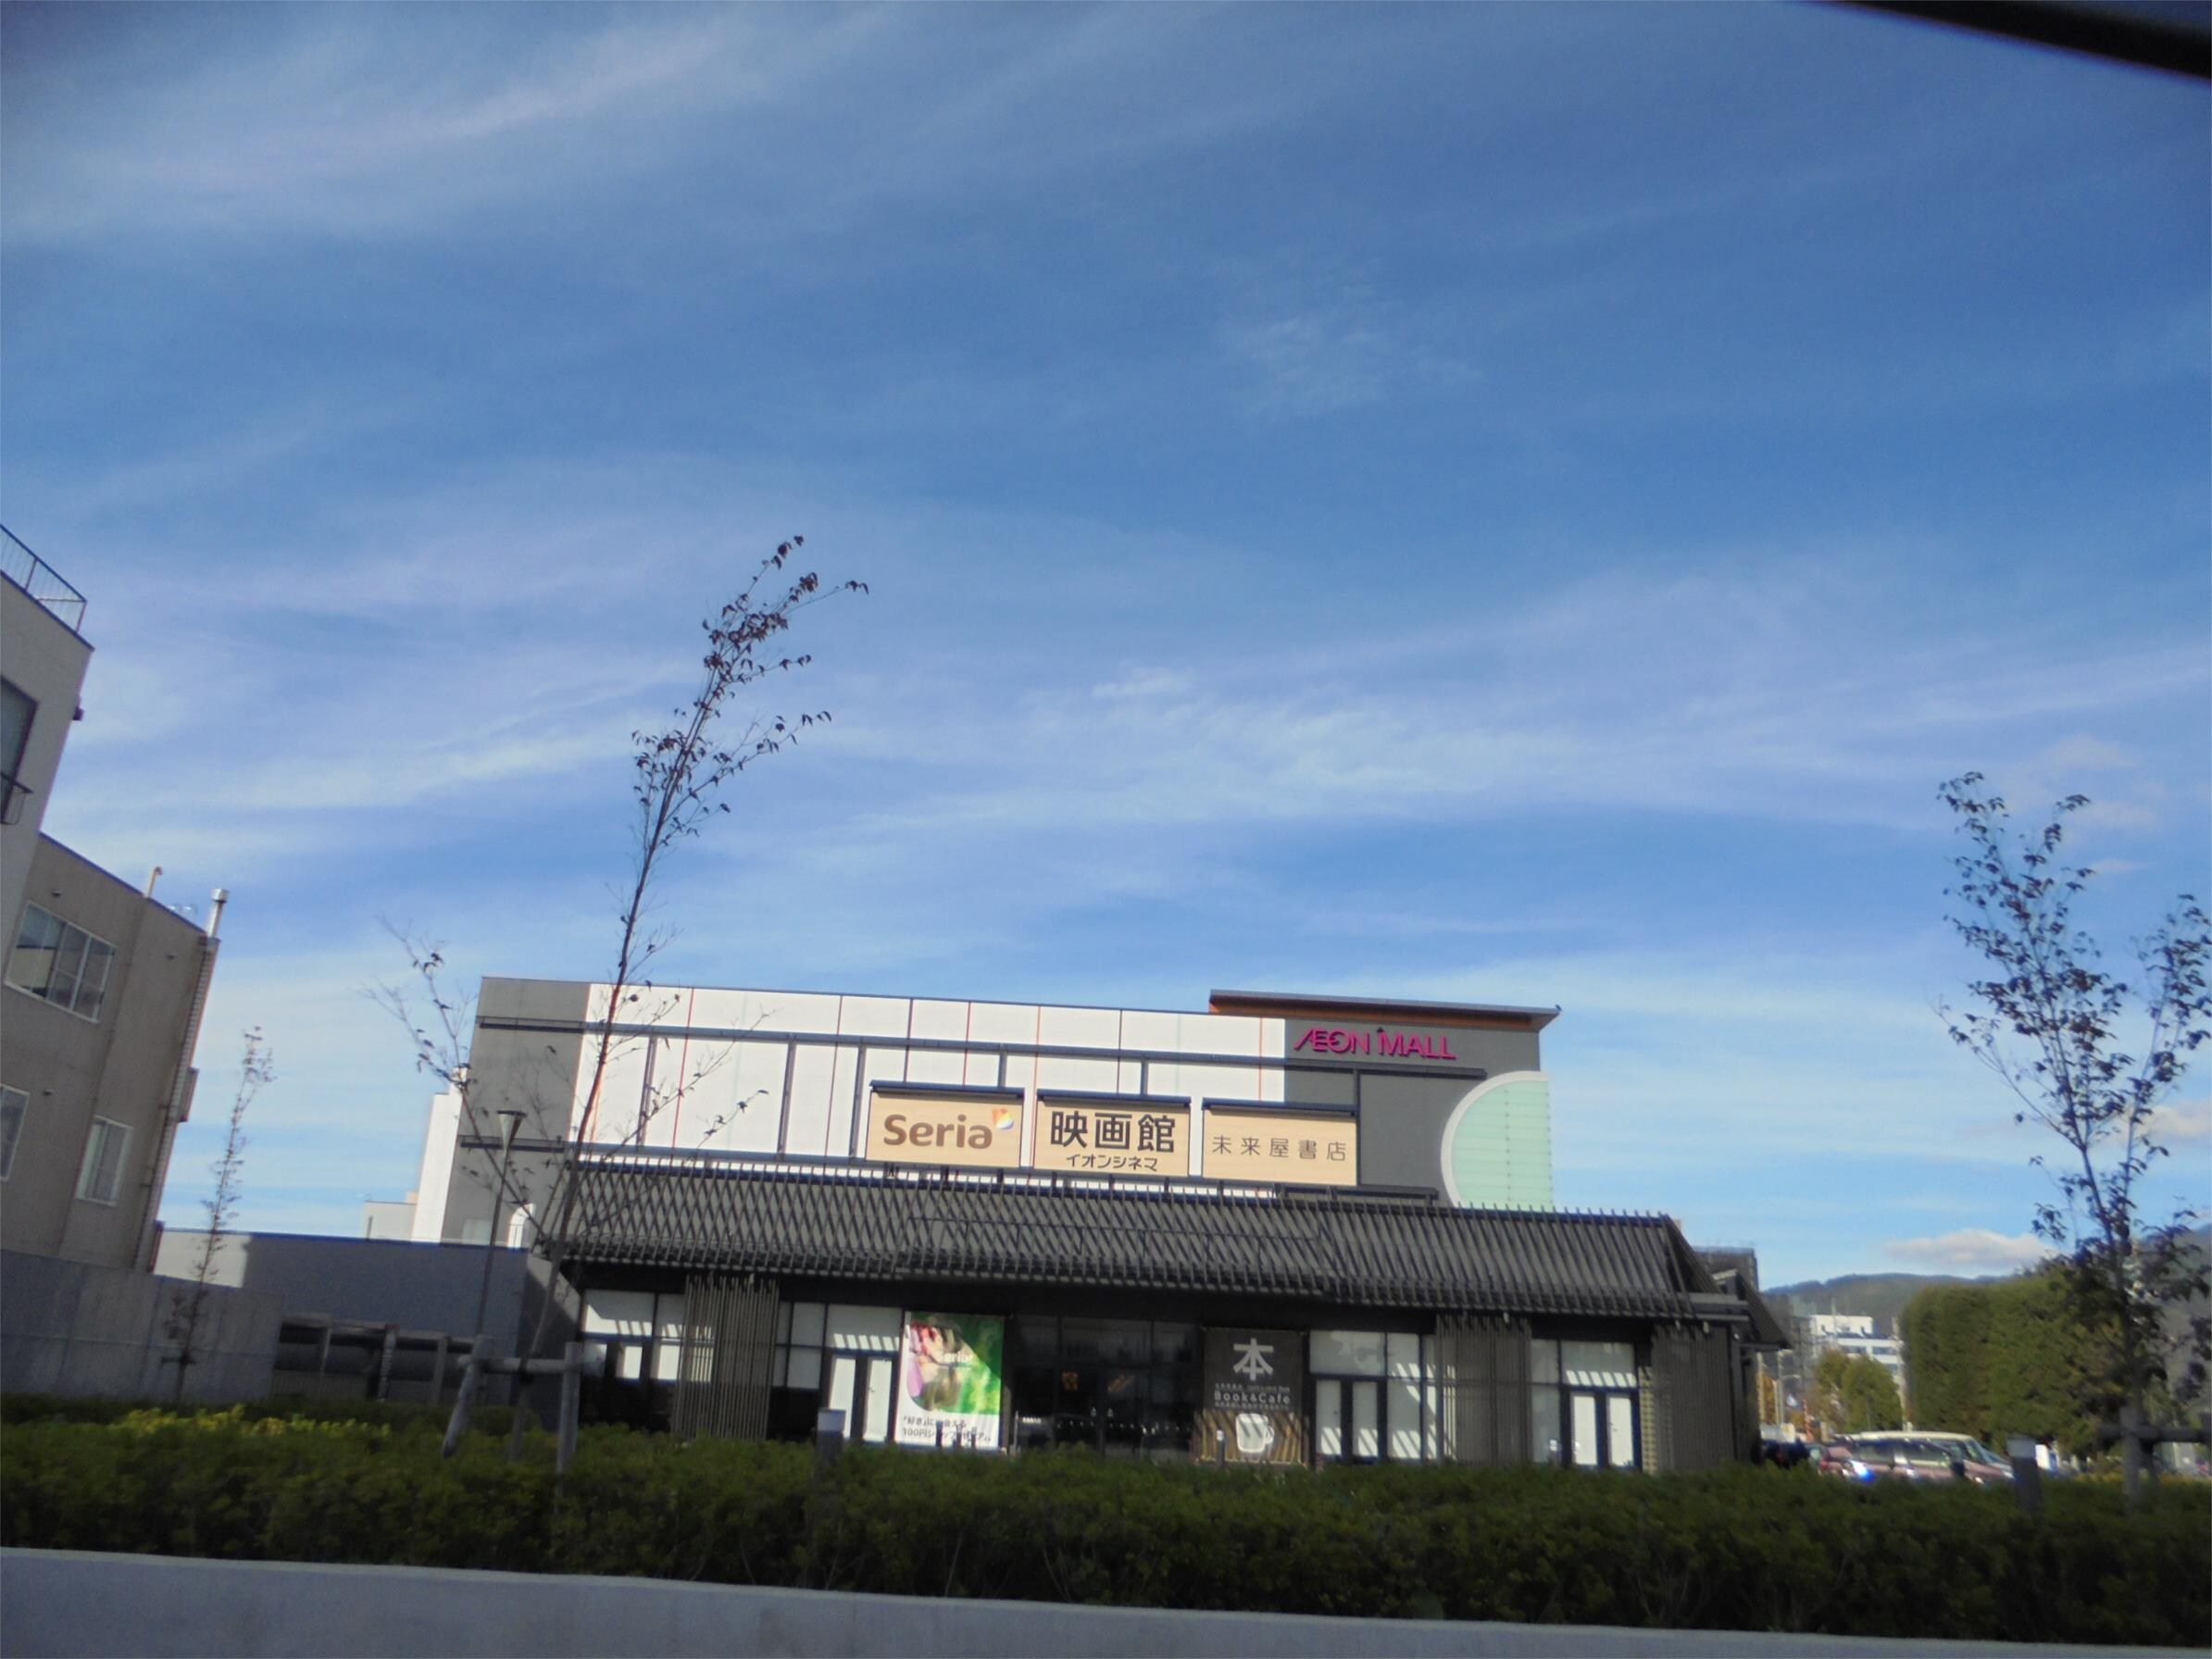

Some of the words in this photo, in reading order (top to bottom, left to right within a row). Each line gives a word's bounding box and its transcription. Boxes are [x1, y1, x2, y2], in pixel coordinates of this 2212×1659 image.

[1378, 1030, 1456, 1060] MALL
[883, 1114, 993, 1150] Seria
[1050, 1110, 1176, 1154] 映画館
[1212, 1125, 1347, 1162] 未来屋書店
[1066, 1154, 1158, 1172] イオンシネマ
[1232, 1337, 1274, 1380] 本
[1214, 1391, 1290, 1404] Book&Cafe
